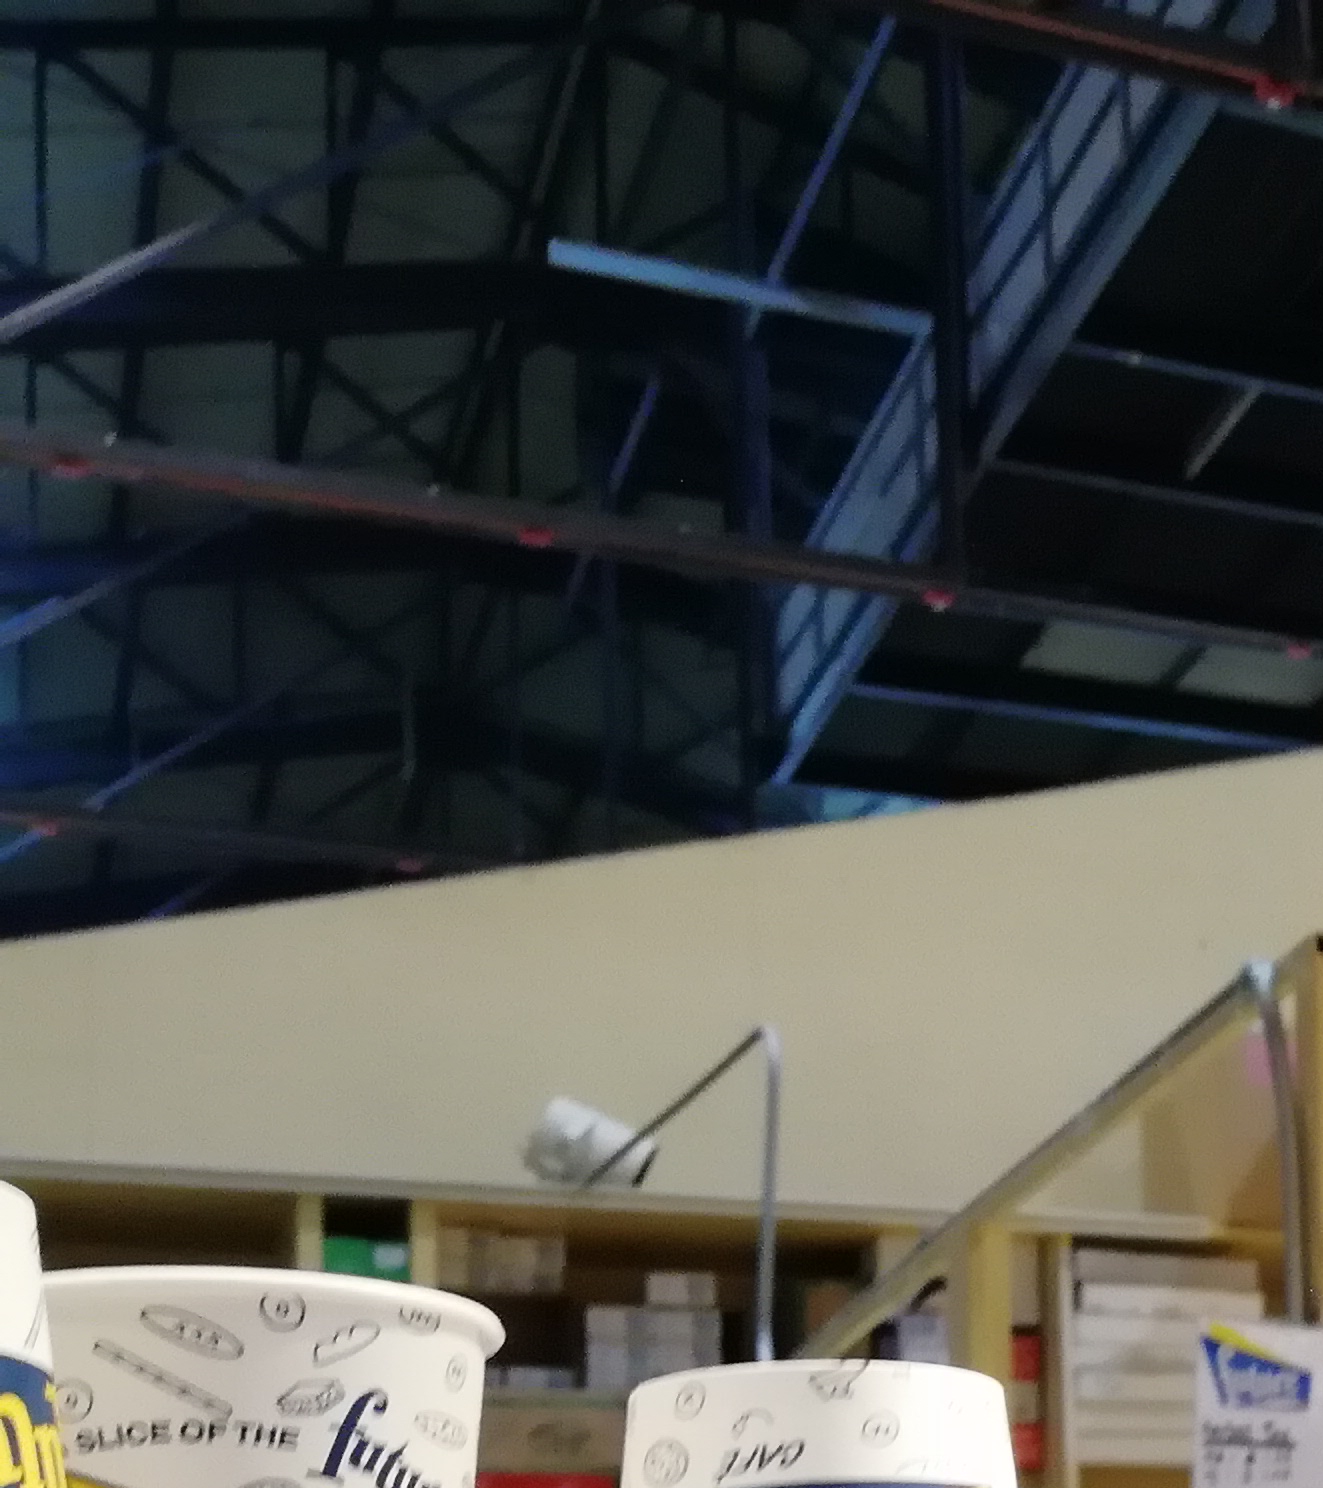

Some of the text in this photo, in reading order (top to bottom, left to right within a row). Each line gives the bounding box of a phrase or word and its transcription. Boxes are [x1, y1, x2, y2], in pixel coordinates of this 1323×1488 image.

[75, 1418, 172, 1454] SLICE
[179, 1419, 227, 1446] OF
[235, 1419, 301, 1451] THE
